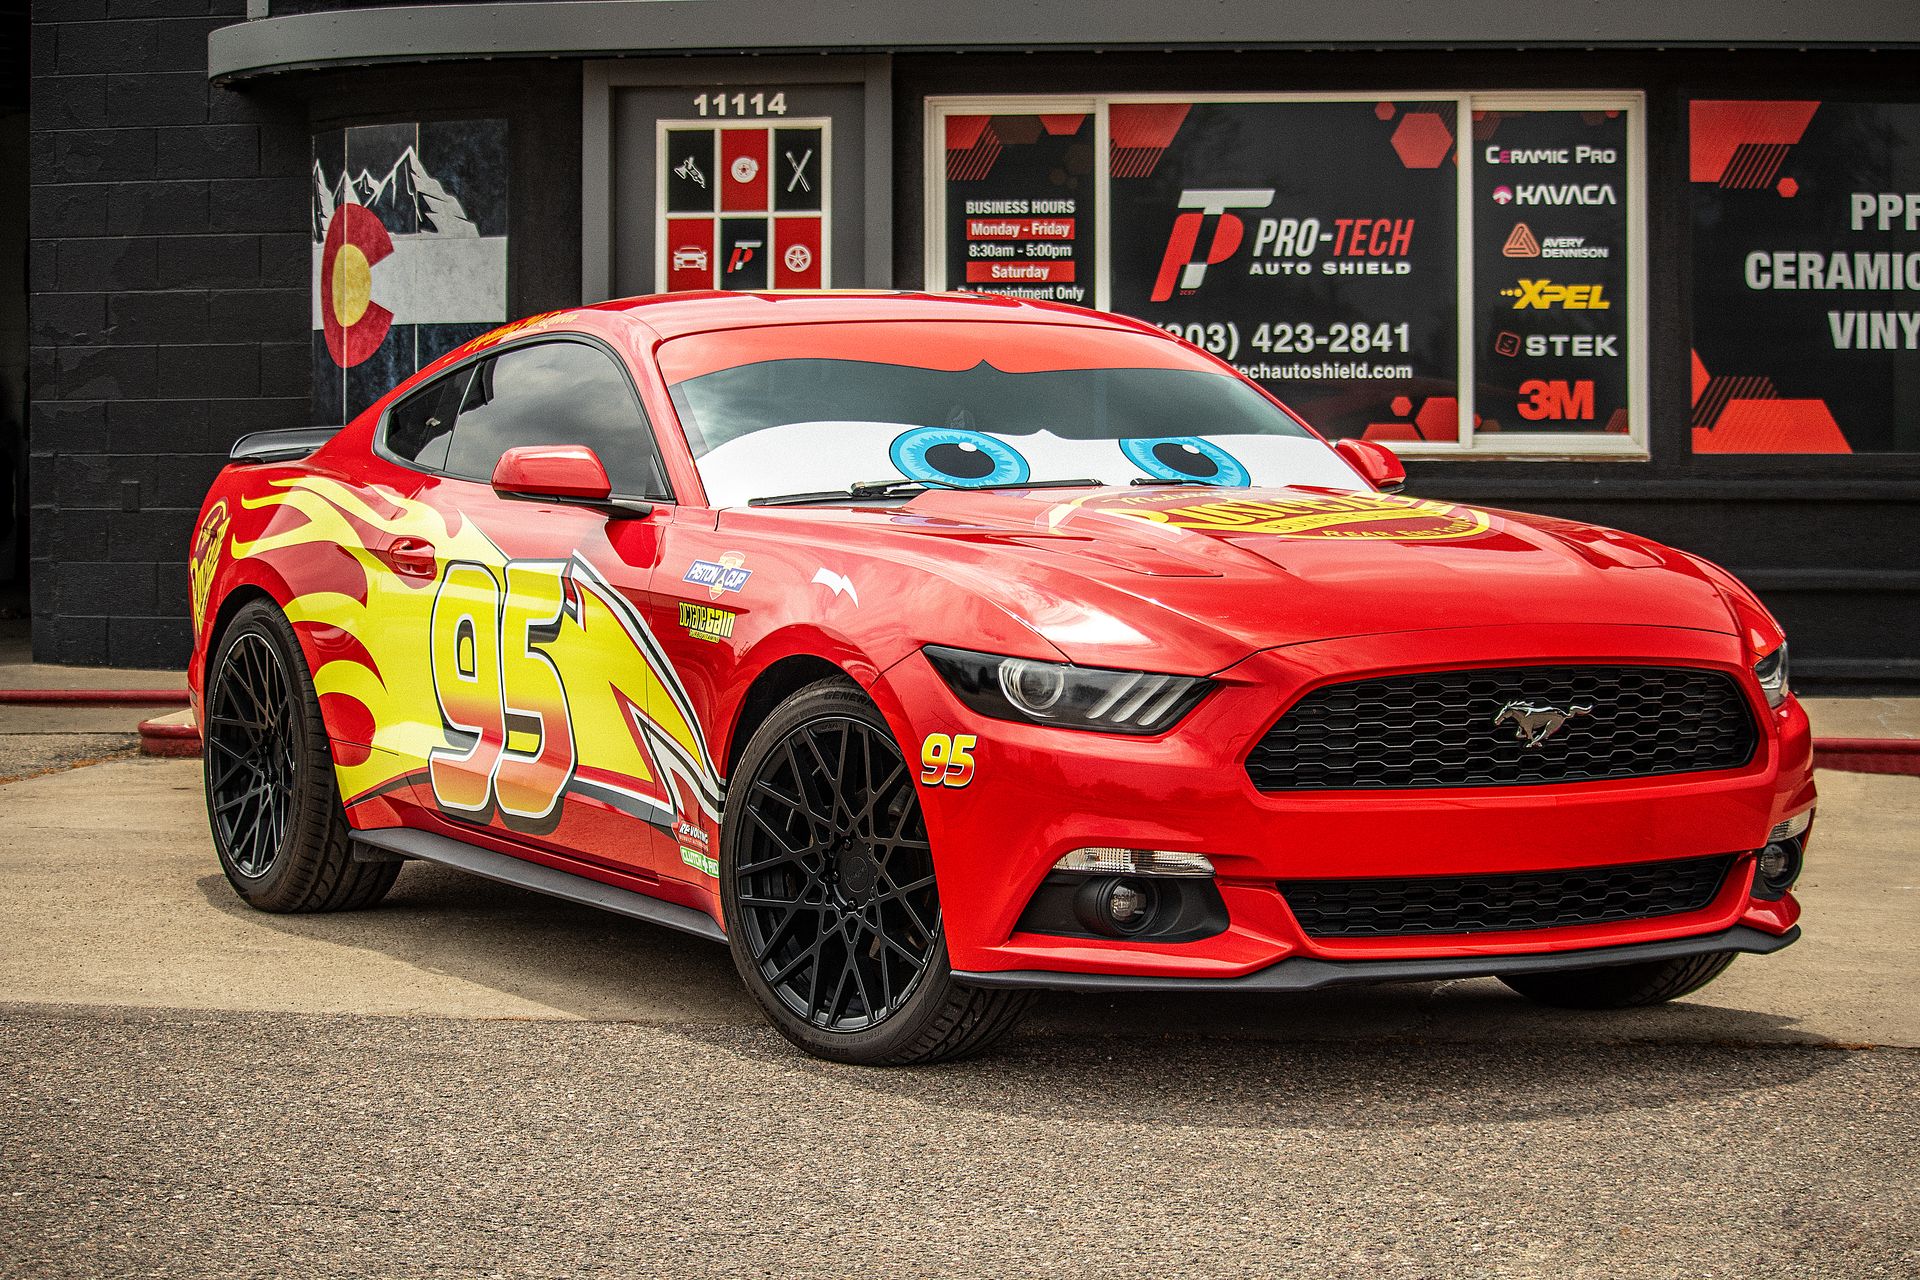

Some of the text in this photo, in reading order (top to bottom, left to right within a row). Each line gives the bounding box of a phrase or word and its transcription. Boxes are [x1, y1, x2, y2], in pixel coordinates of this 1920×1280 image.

[693, 93, 787, 116] 11114
[1516, 185, 1617, 205] KAVACA
[966, 200, 1075, 214] BUSINESS HOURS
[971, 223, 1020, 238] Monday
[1032, 223, 1070, 238] Friday
[1253, 218, 1415, 257] PRO-TECH
[969, 244, 1014, 257] 8:30am
[1026, 244, 1072, 259] 5:00pm
[1542, 238, 1584, 248] AVERY
[1542, 248, 1609, 258] DENNISON
[991, 265, 1050, 280] Saturday
[1249, 262, 1412, 276] AUTO SHIELD
[1745, 252, 1920, 290] CERAMIC
[1056, 286, 1085, 302] Only
[1513, 280, 1610, 309] XPEL
[1156, 322, 1410, 360] 03) 423-2841
[1526, 335, 1618, 357] STEK
[1517, 380, 1595, 420] 3M
[687, 563, 747, 588] PISTON CUP
[427, 560, 577, 820] 95
[921, 732, 977, 788] 95
